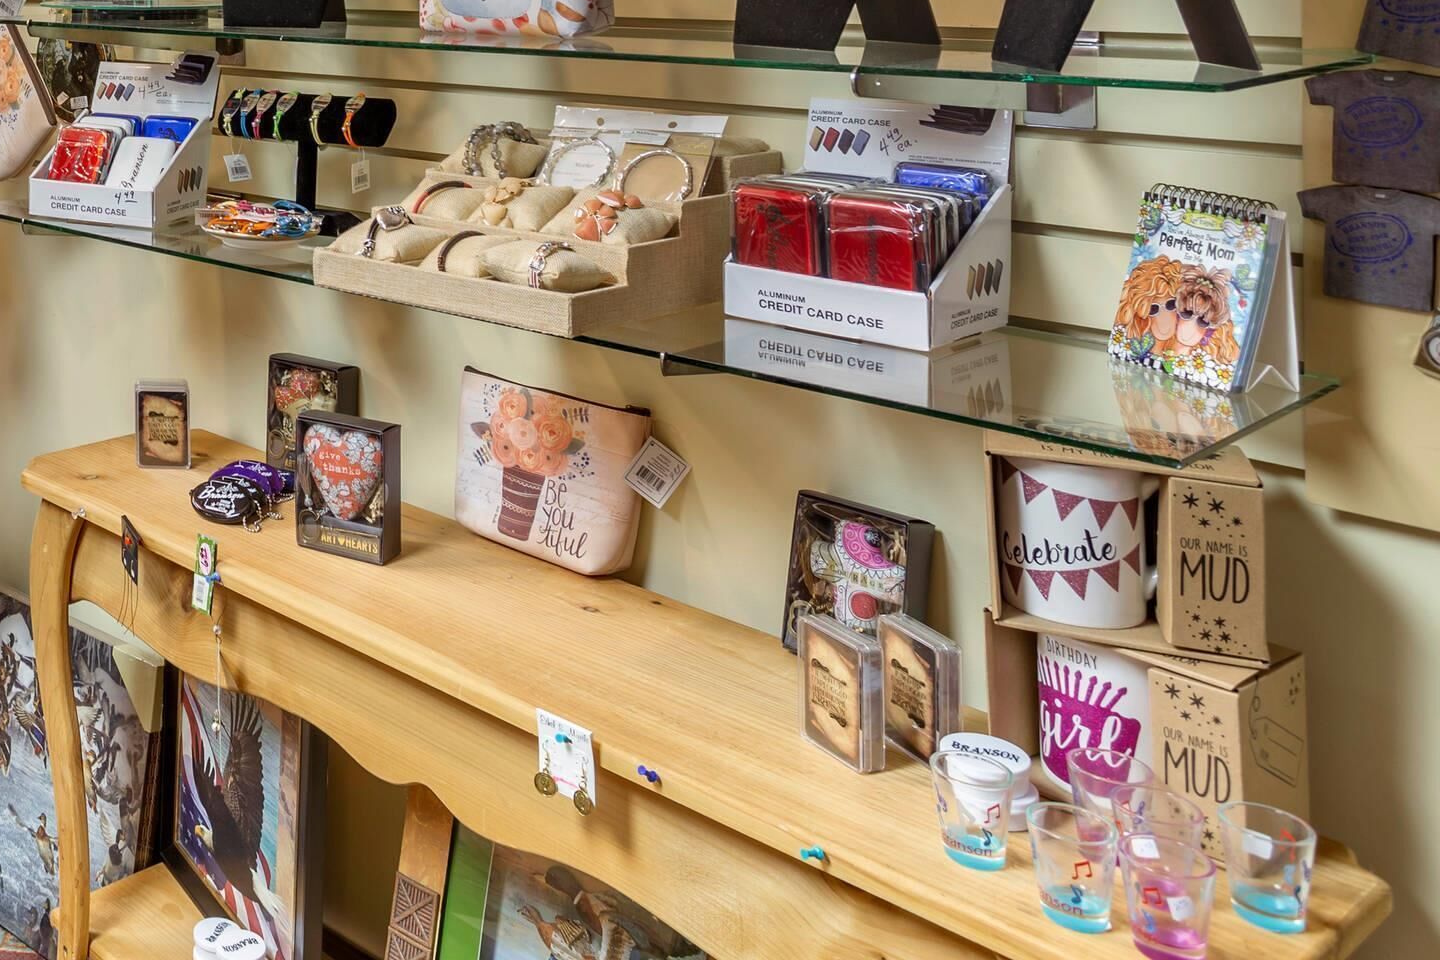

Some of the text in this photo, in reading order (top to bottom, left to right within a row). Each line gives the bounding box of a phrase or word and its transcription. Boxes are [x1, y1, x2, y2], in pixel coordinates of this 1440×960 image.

[811, 115, 892, 127] CREDIT CARD CASE
[120, 143, 149, 189] Branson
[50, 194, 81, 203] ALUMINUM
[50, 201, 127, 217] CREDIT CARD CASE
[1205, 242, 1236, 262] Mom
[757, 289, 807, 304] ALUMINUM
[758, 298, 885, 330] CREDIT CARD CASE
[950, 307, 999, 330] CREDIT CARD CASE
[317, 450, 341, 463] give
[322, 462, 361, 477] thanks
[197, 489, 246, 501] Branson
[541, 506, 575, 533] you
[320, 533, 379, 555] ART HEARTS
[1002, 528, 1118, 567] Celebrate
[1179, 536, 1250, 558] OUR NAME IS
[1179, 550, 1250, 605] MUD
[1045, 635, 1098, 671] BIRTHDAY
[1040, 697, 1133, 769] girl
[1162, 725, 1229, 760] OUR NAME IS
[951, 740, 1021, 763] BRANSON
[1163, 740, 1232, 805] MUD
